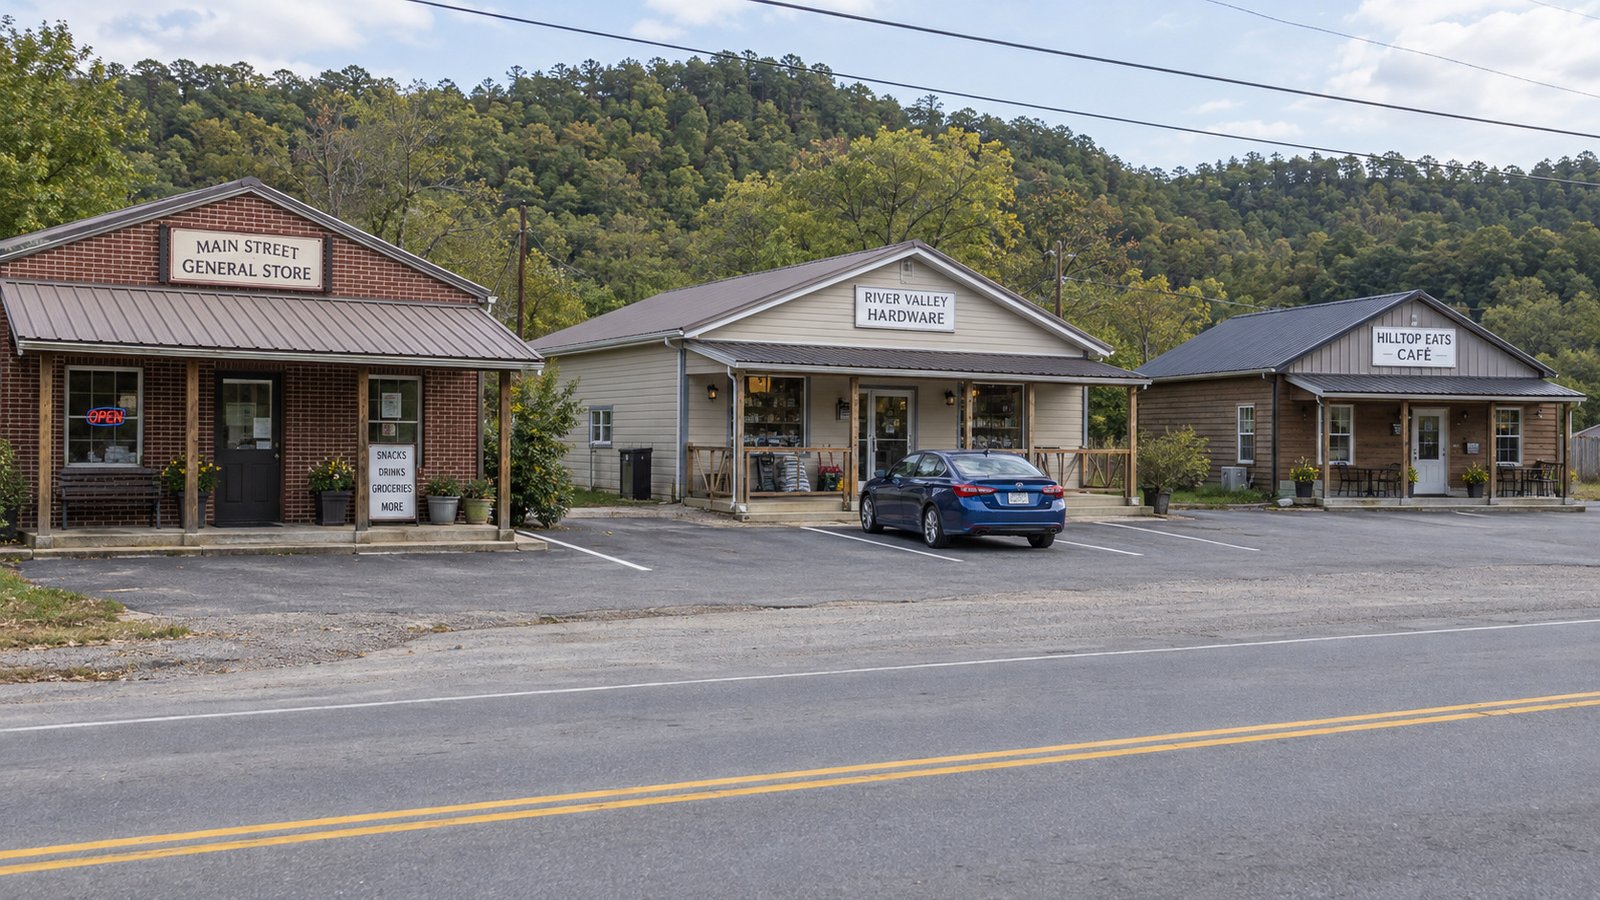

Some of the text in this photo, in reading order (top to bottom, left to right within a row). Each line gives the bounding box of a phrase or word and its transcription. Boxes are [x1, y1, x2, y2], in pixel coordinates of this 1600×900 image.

[196, 239, 299, 260] MAIN STREET
[182, 258, 311, 280] GENERAL STORE
[865, 292, 948, 307] RIVER VALLEY
[868, 308, 945, 324] HARDWARE
[1377, 332, 1451, 345] HILLTOP EATS
[89, 410, 123, 424] OPEN
[376, 450, 407, 460] SNACKS
[378, 467, 406, 477] DRINKS
[371, 483, 413, 494] GROCERIES
[381, 501, 404, 512] MORE
